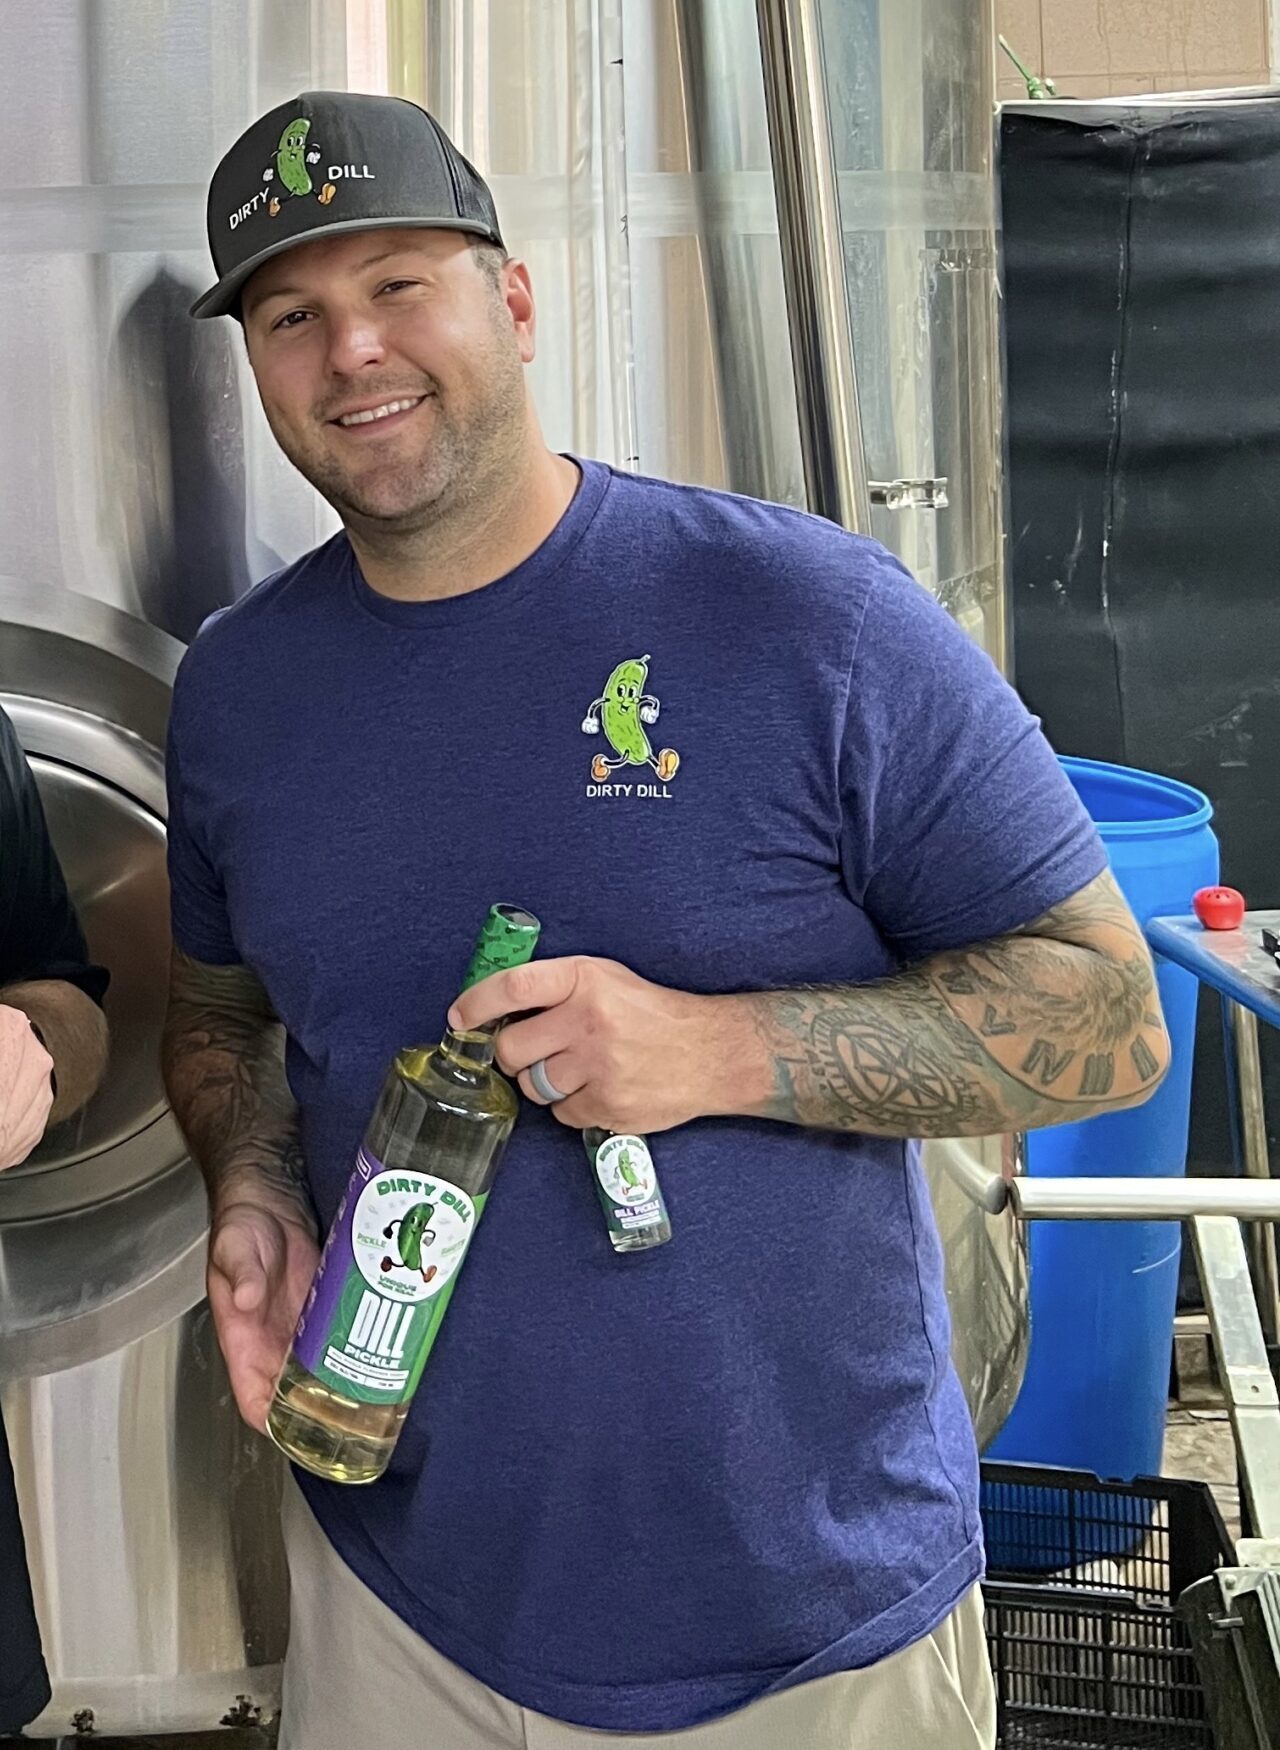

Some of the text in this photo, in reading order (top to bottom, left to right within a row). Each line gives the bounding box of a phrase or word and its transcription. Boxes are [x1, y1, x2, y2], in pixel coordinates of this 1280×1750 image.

[229, 165, 375, 229] DIRTY DILL
[586, 785, 672, 798] DIRTY DILL
[376, 1178, 471, 1223] DIRTY DILL
[347, 1289, 416, 1358] DILL
[344, 1343, 400, 1369] PICKLE
